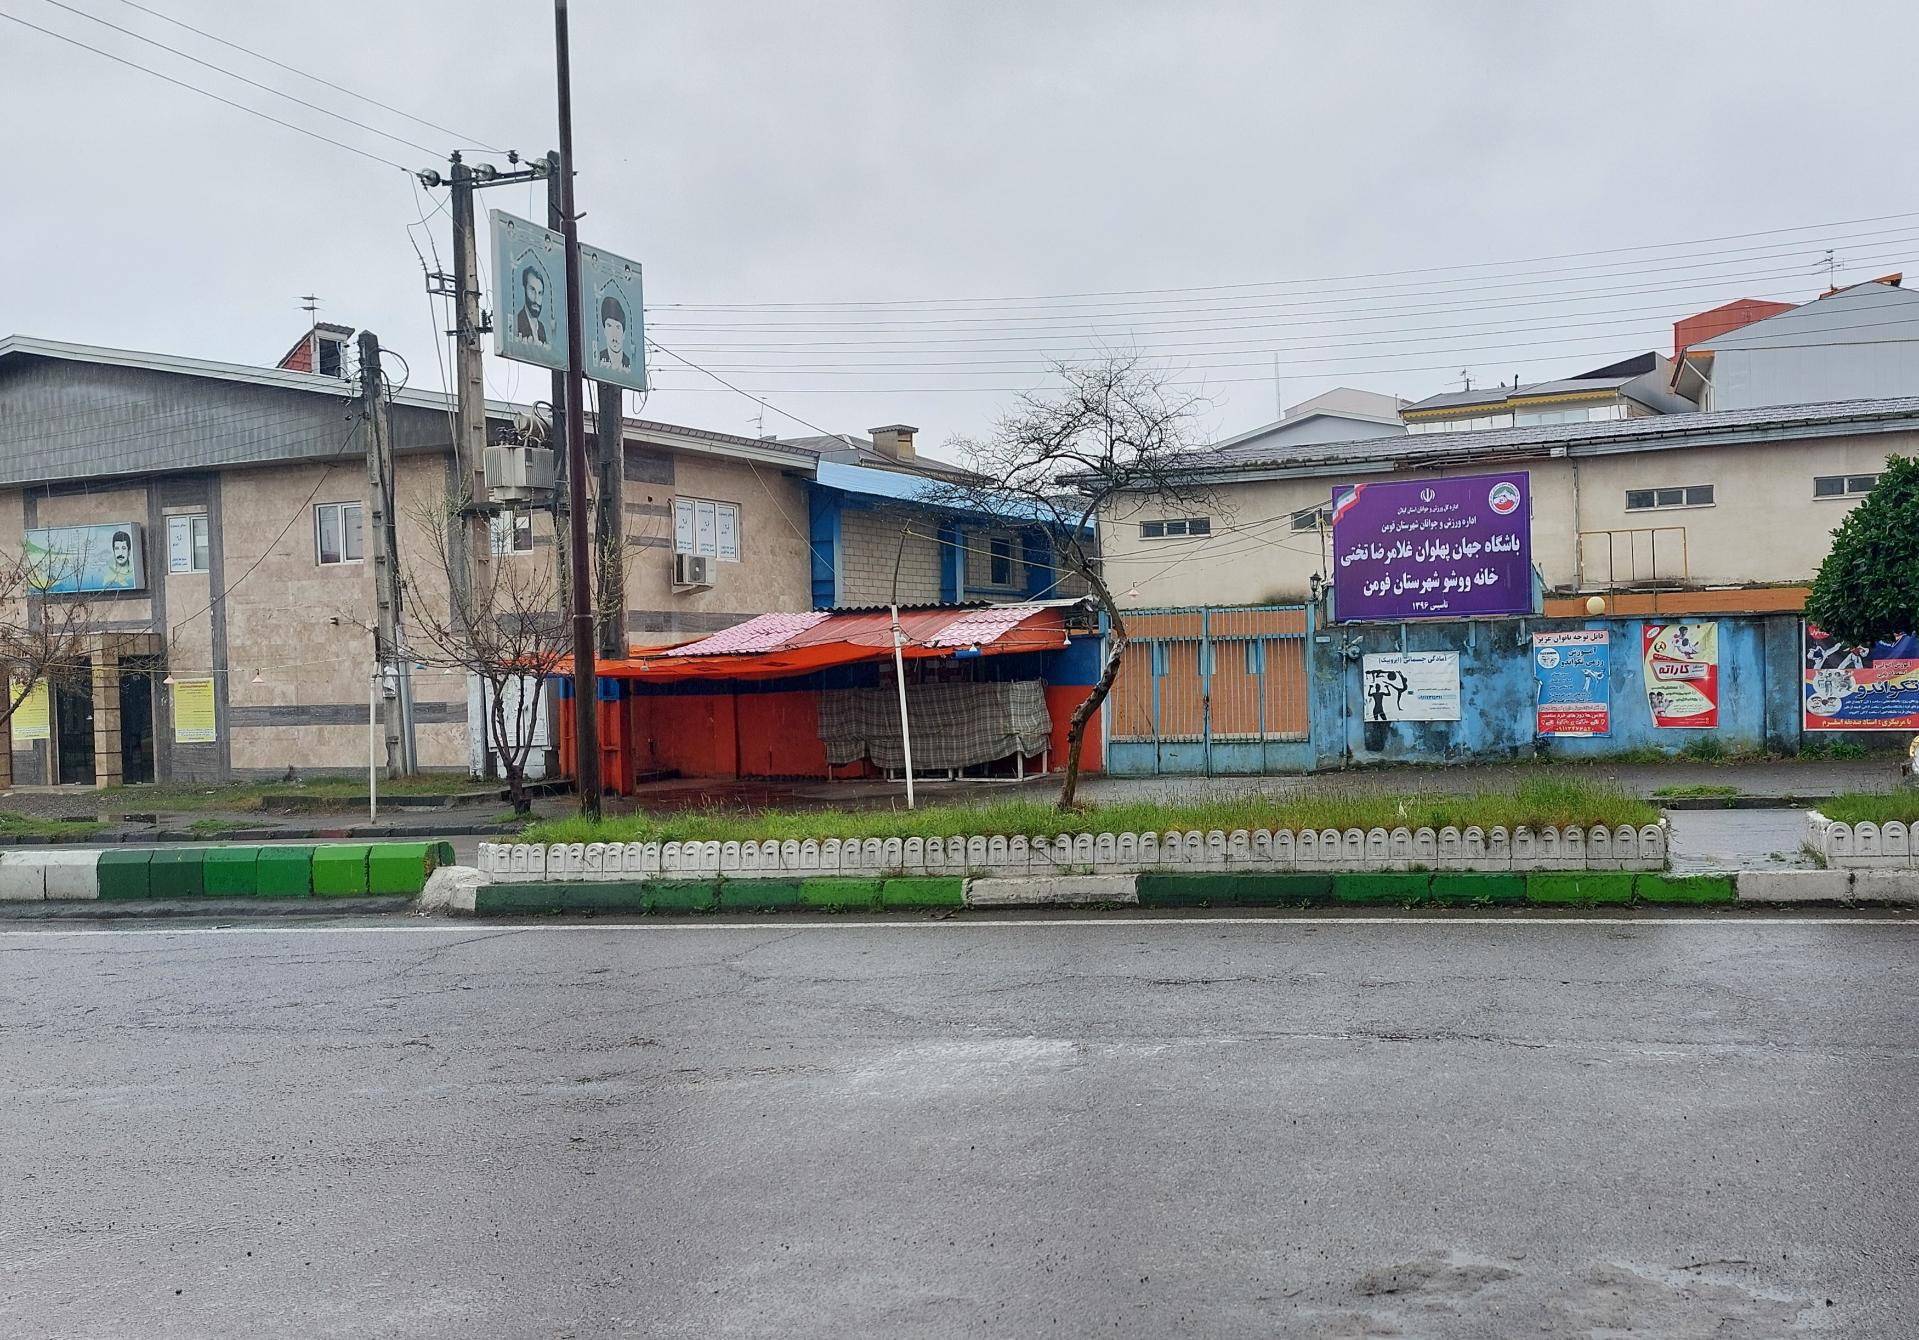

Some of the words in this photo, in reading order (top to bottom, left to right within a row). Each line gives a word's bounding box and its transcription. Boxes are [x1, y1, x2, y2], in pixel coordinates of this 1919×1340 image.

[1432, 505, 1444, 513] ورزش
[1381, 520, 1396, 533] فومن
[1396, 519, 1419, 532] شهرستان
[1420, 518, 1438, 530] جوانان
[1444, 517, 1462, 529] ورزش
[1462, 515, 1477, 528] اداره
[1371, 539, 1413, 565] غلامرضا
[1415, 538, 1450, 562] پهلوان
[1452, 536, 1482, 560] جهان
[1484, 533, 1520, 556] باشگاه
[1340, 543, 1369, 567] تختی
[1363, 572, 1391, 597] فومن
[1393, 570, 1440, 595] شهرستان
[1442, 569, 1472, 593] ووشو
[1473, 567, 1499, 586] خانه
[1412, 601, 1429, 610] ۱۳۹۶
[1659, 664, 1690, 676] کاراته
[1855, 678, 1919, 700] تکواندو
